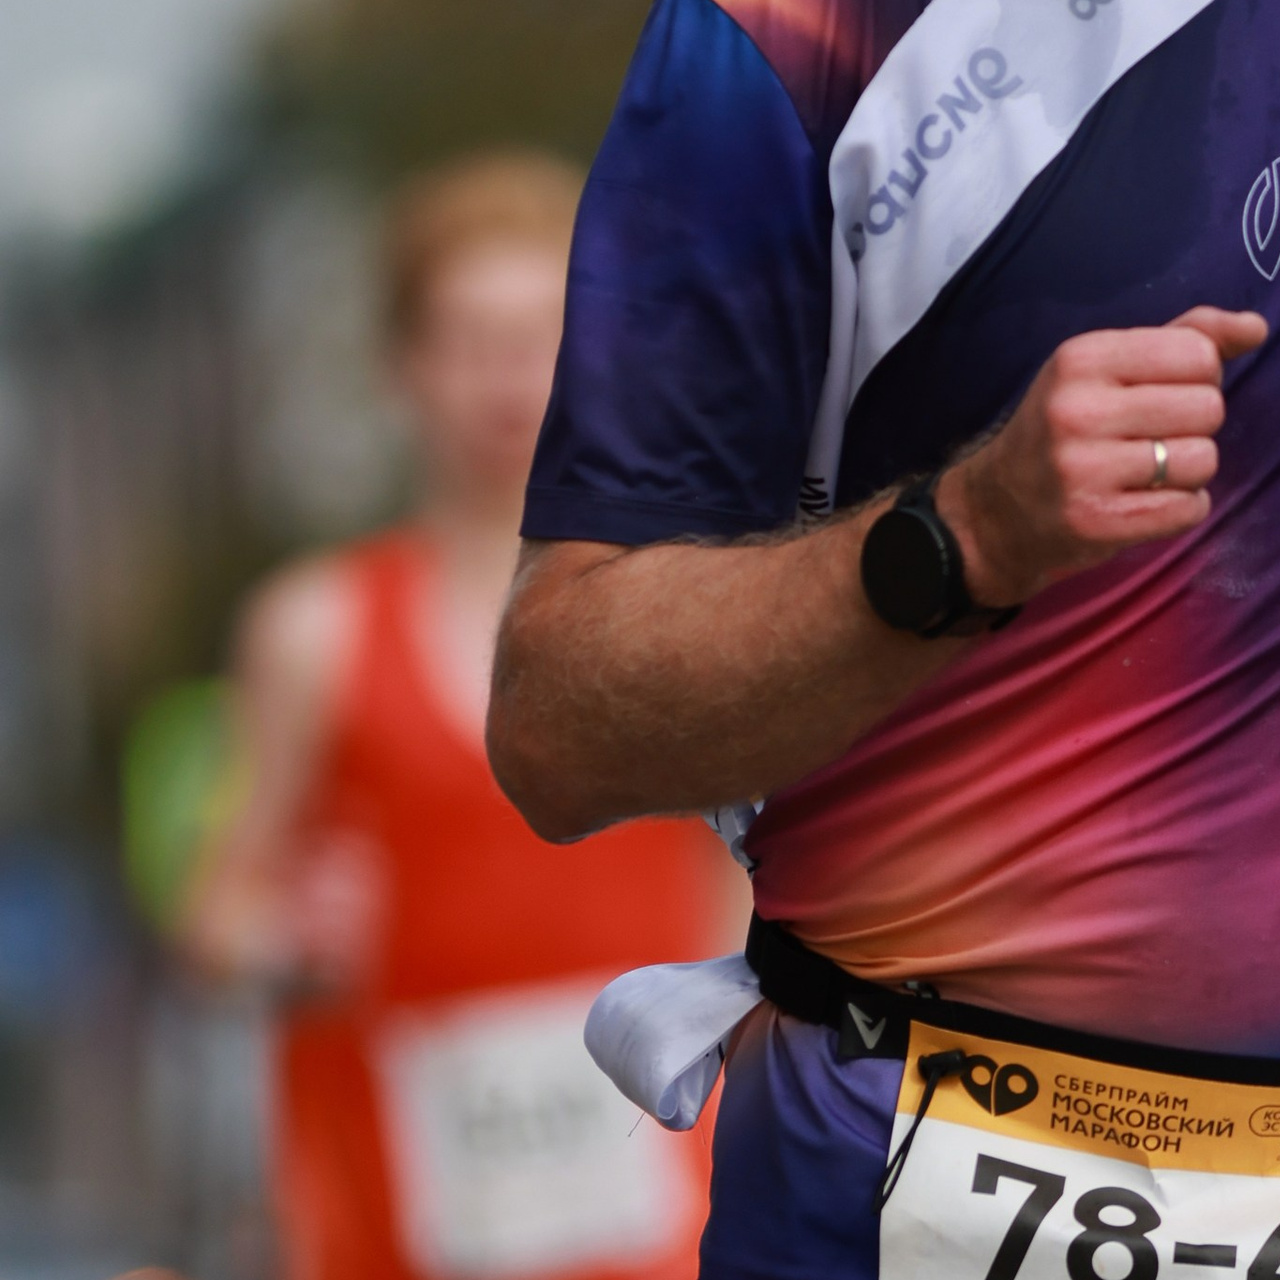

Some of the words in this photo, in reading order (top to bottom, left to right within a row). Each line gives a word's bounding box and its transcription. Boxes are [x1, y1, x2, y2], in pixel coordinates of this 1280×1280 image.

[1054, 1073, 1189, 1112] СБЕРПРАЙМ
[1050, 1112, 1182, 1153] МАРАФОН
[1052, 1091, 1235, 1138] МОСКОВСКИЙ
